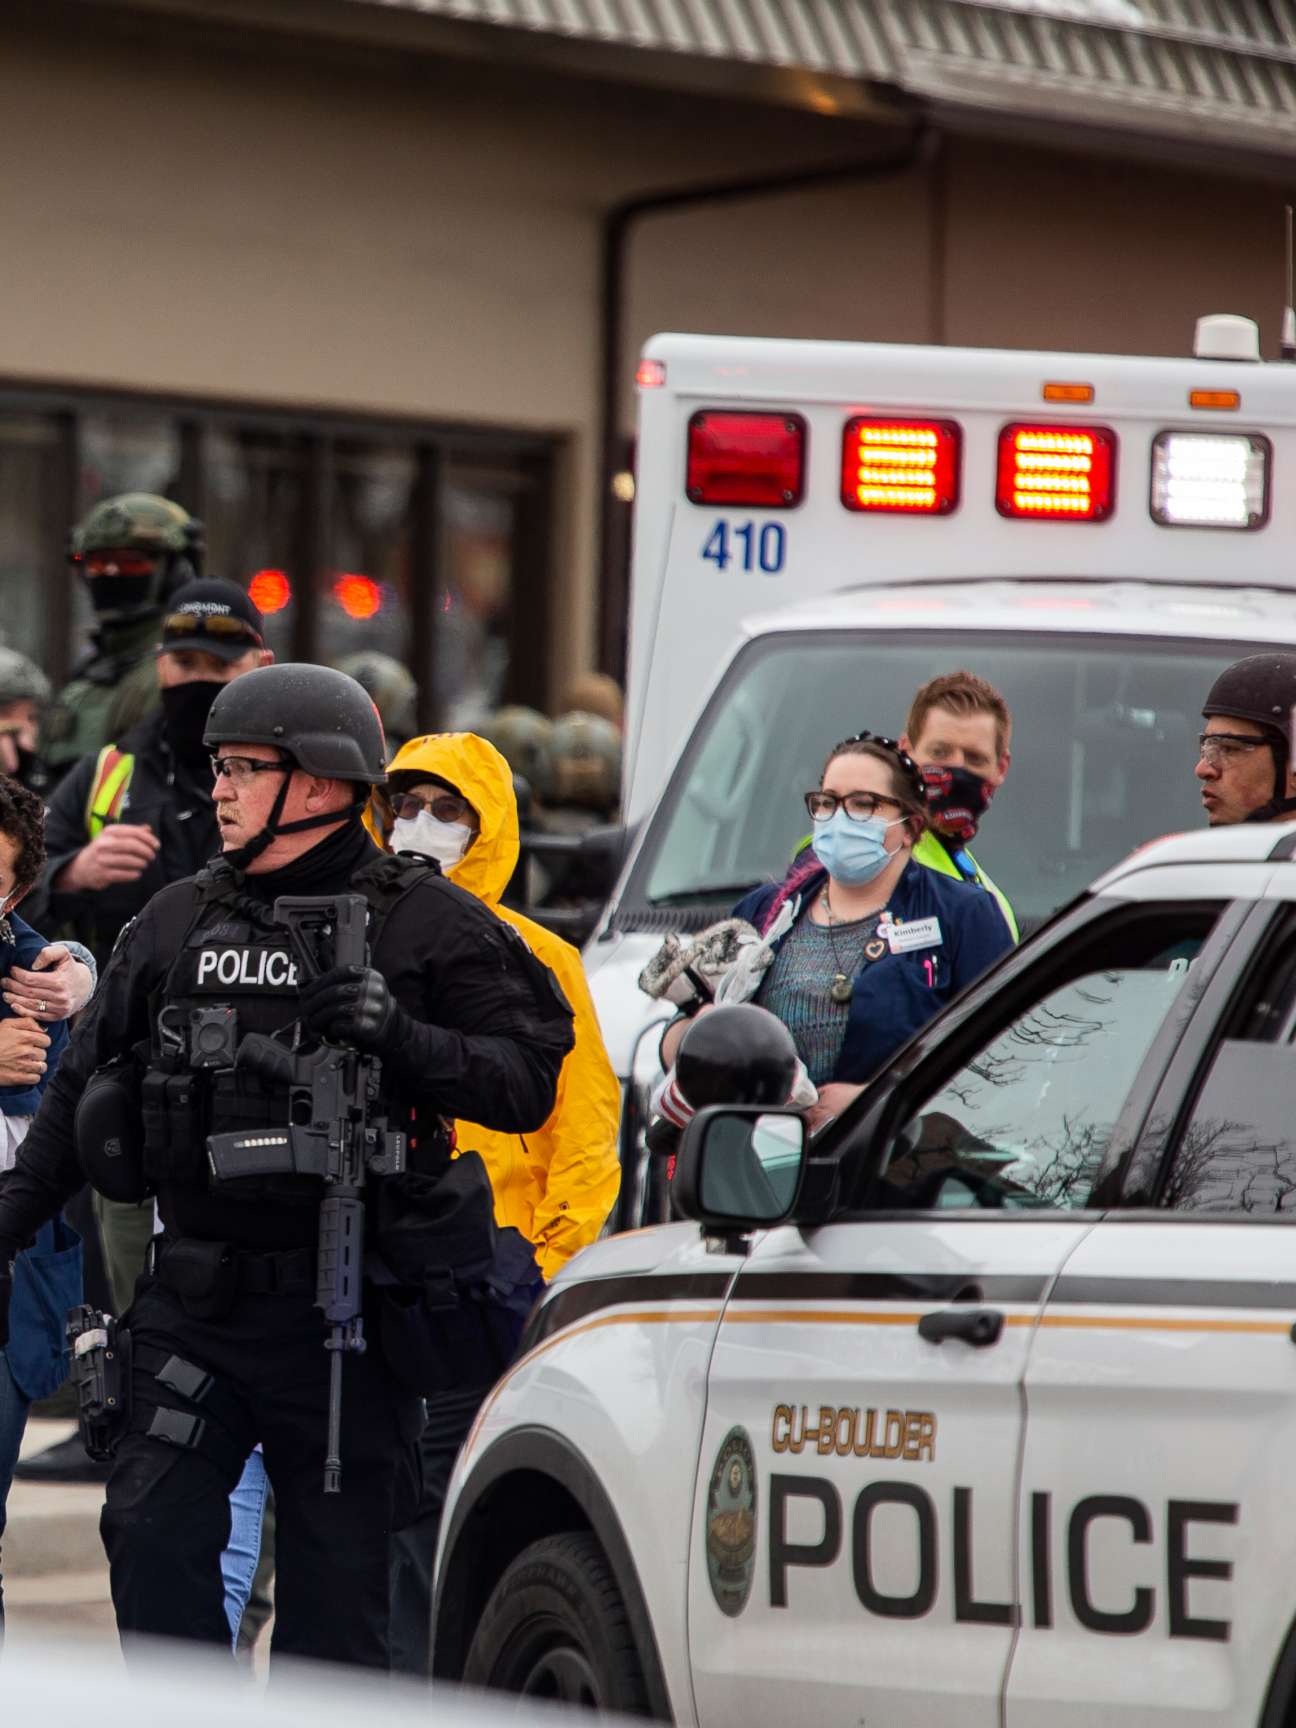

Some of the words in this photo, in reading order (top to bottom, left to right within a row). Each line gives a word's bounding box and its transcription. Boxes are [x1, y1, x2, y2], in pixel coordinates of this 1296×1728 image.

[702, 520, 787, 575] 410
[894, 924, 933, 937] Kimberly
[771, 1403, 937, 1462] CU-BOULDER
[768, 1473, 1240, 1641] POLICE
